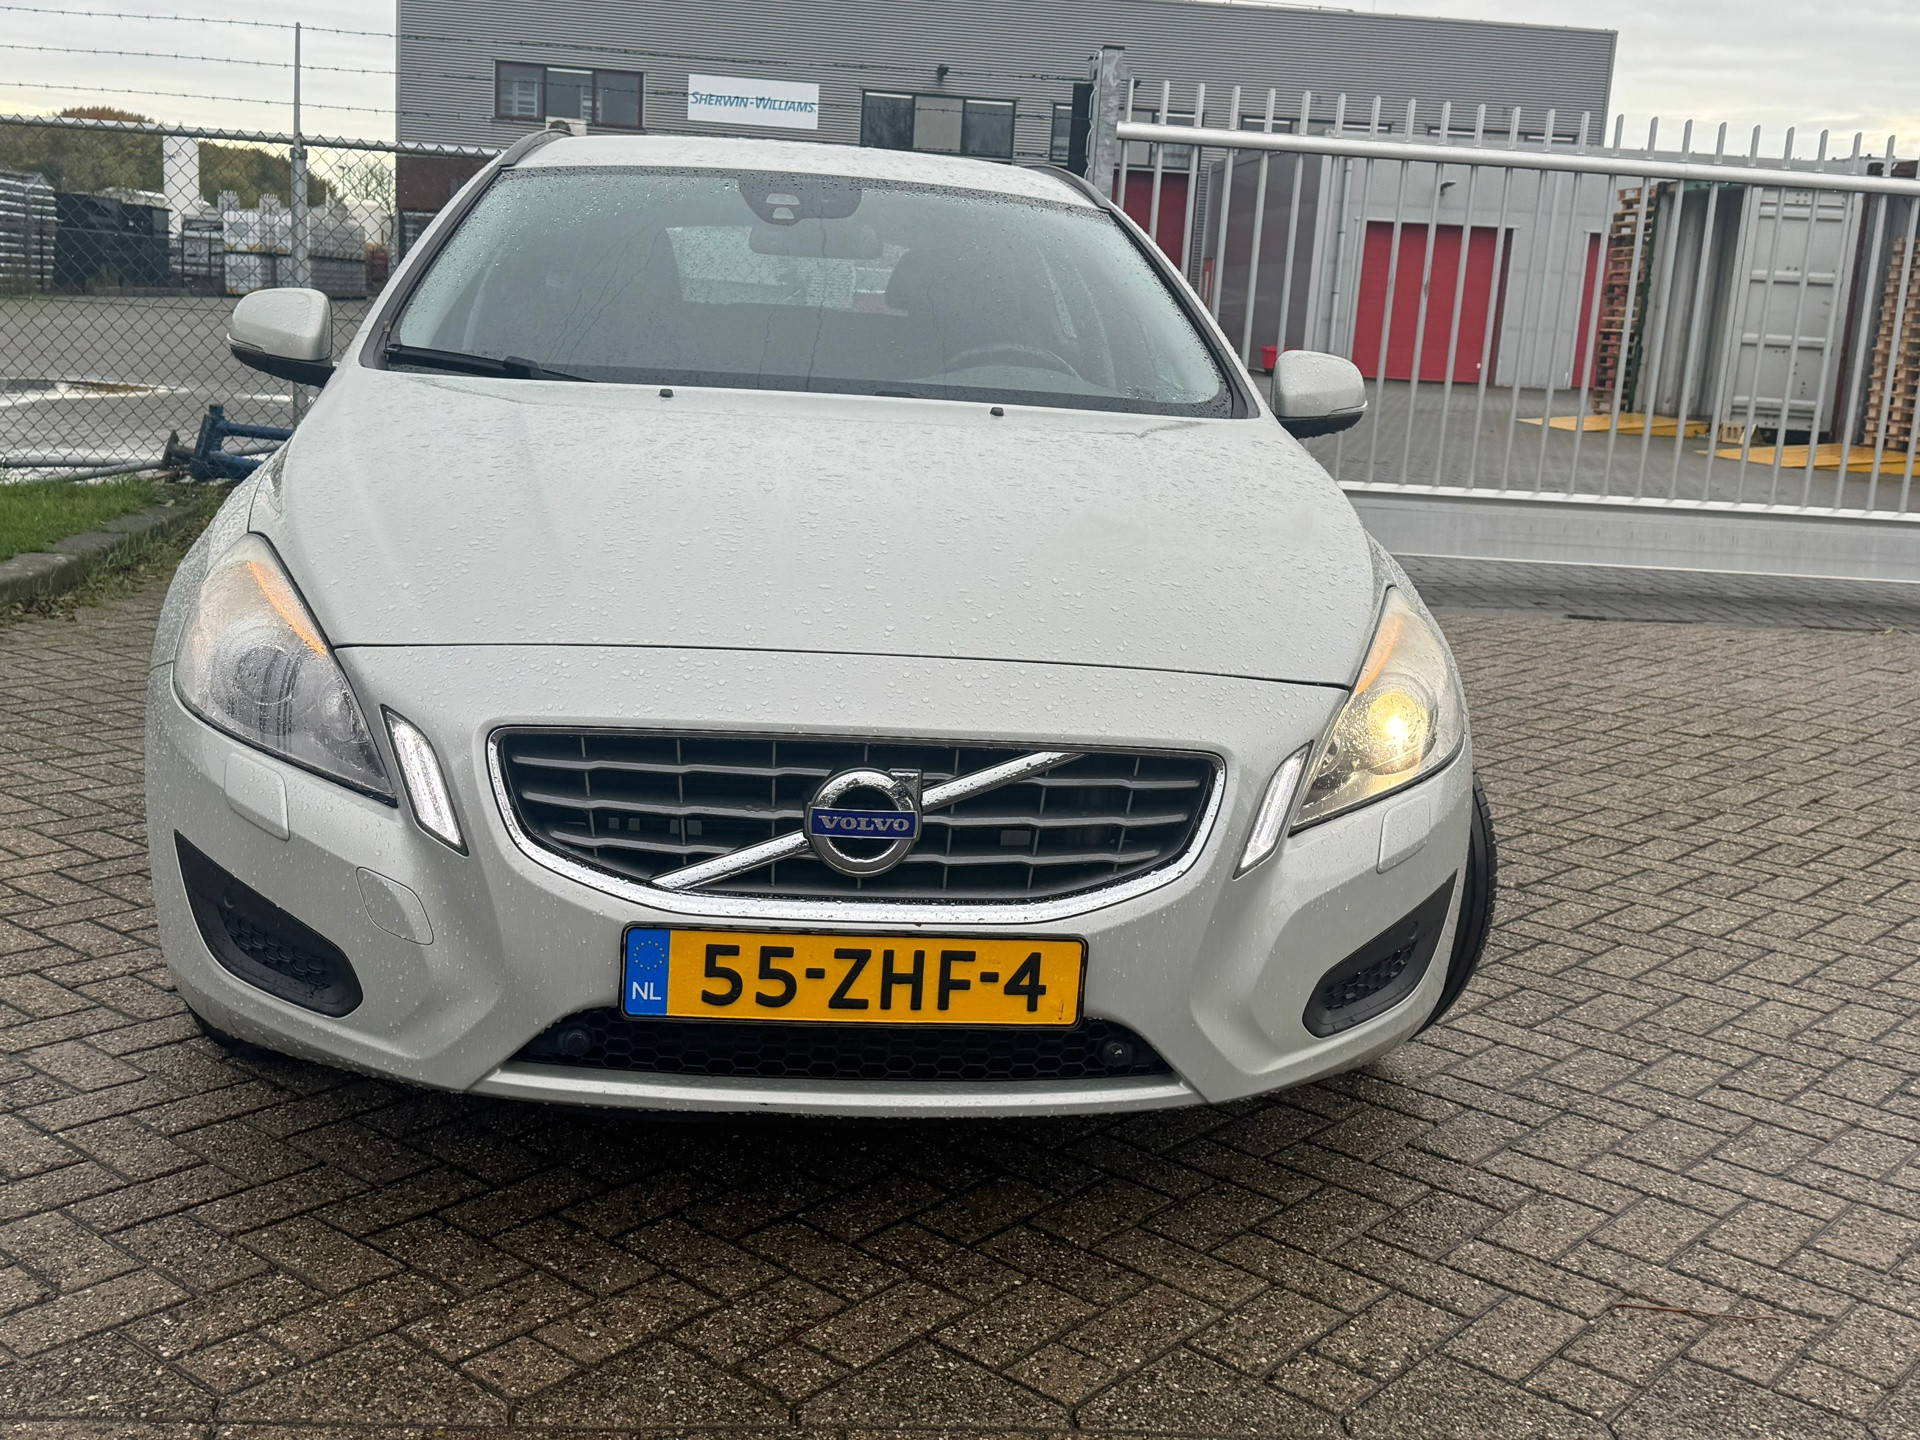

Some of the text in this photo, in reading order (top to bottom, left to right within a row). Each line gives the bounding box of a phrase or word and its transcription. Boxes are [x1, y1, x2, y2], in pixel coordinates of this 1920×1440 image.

[818, 815, 910, 832] VOLVO
[701, 944, 1047, 1012] 55-ZHF-4
[631, 981, 662, 1001] NL
